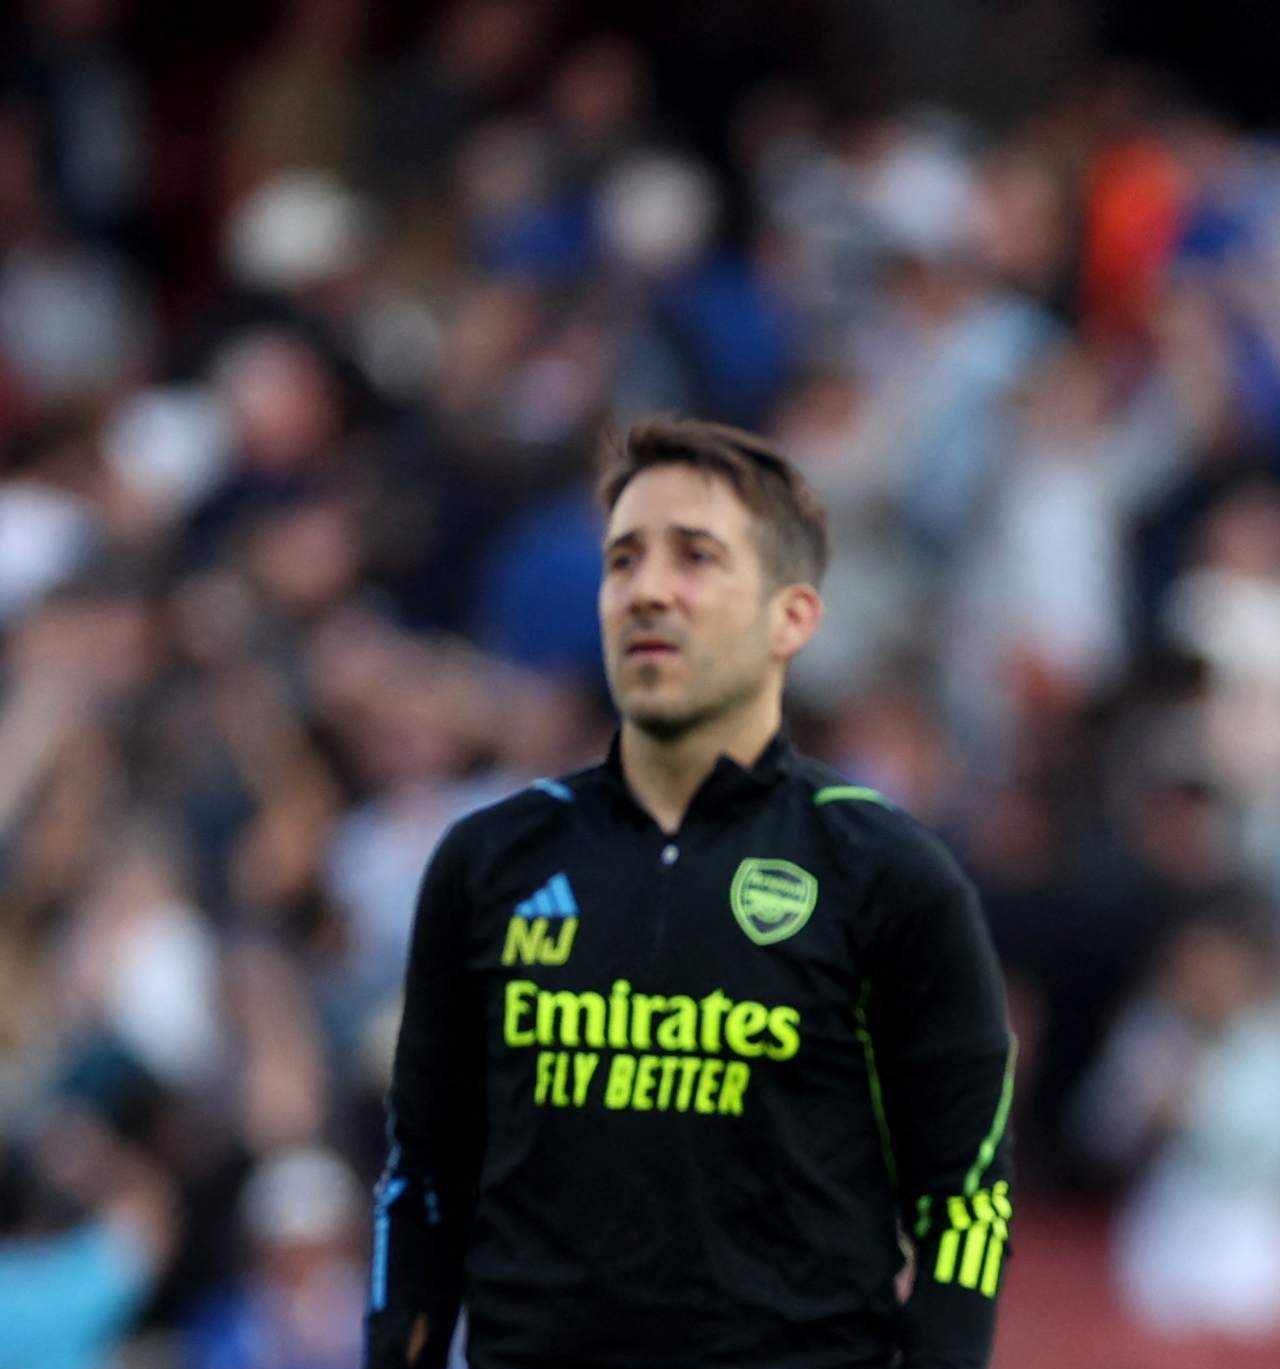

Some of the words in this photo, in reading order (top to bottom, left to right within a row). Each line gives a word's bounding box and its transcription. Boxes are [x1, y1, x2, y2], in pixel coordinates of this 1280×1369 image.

[502, 915, 579, 966] NJ
[504, 979, 800, 1061] Emirates
[534, 1051, 599, 1108] FLY
[605, 1053, 750, 1117] BETTER
